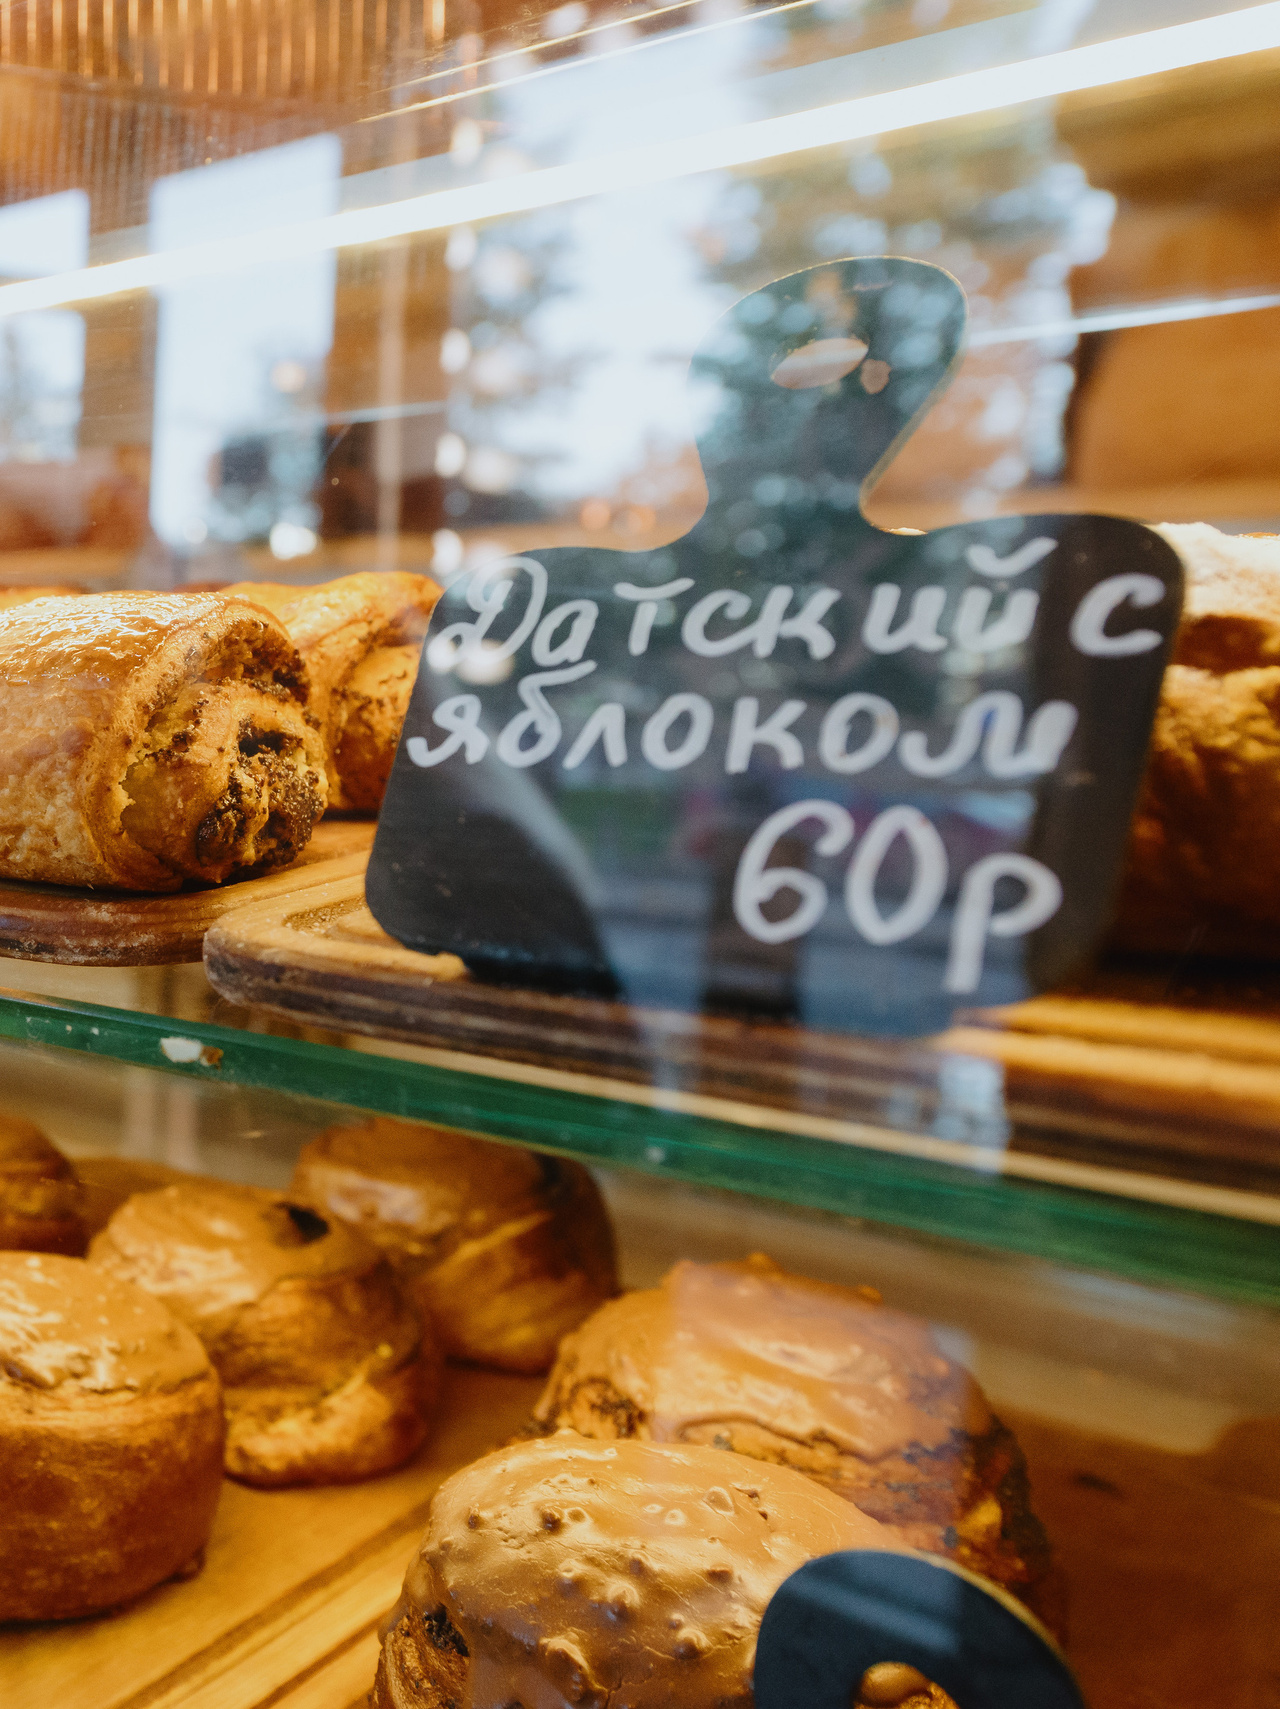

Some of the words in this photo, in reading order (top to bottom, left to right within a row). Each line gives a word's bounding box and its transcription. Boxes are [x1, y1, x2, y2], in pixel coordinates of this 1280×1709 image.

[426, 537, 1058, 668] Датский
[1069, 573, 1166, 657] с
[407, 660, 1079, 779] яблоком
